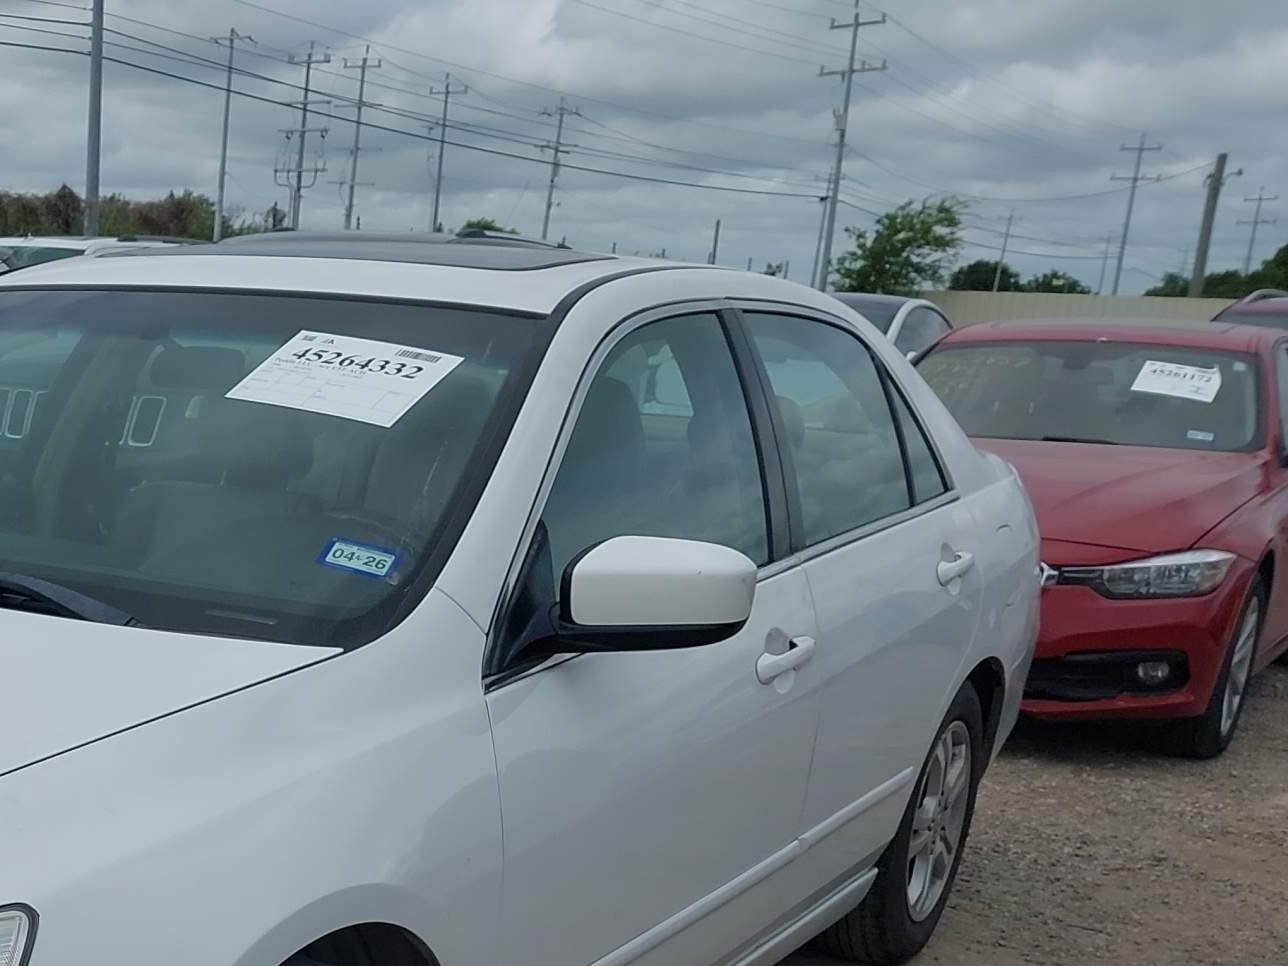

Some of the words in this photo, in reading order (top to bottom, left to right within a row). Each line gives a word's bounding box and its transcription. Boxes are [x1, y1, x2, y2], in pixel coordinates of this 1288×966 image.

[292, 347, 424, 380] 45264332
[332, 548, 355, 562] 04
[362, 556, 388, 570] 26
